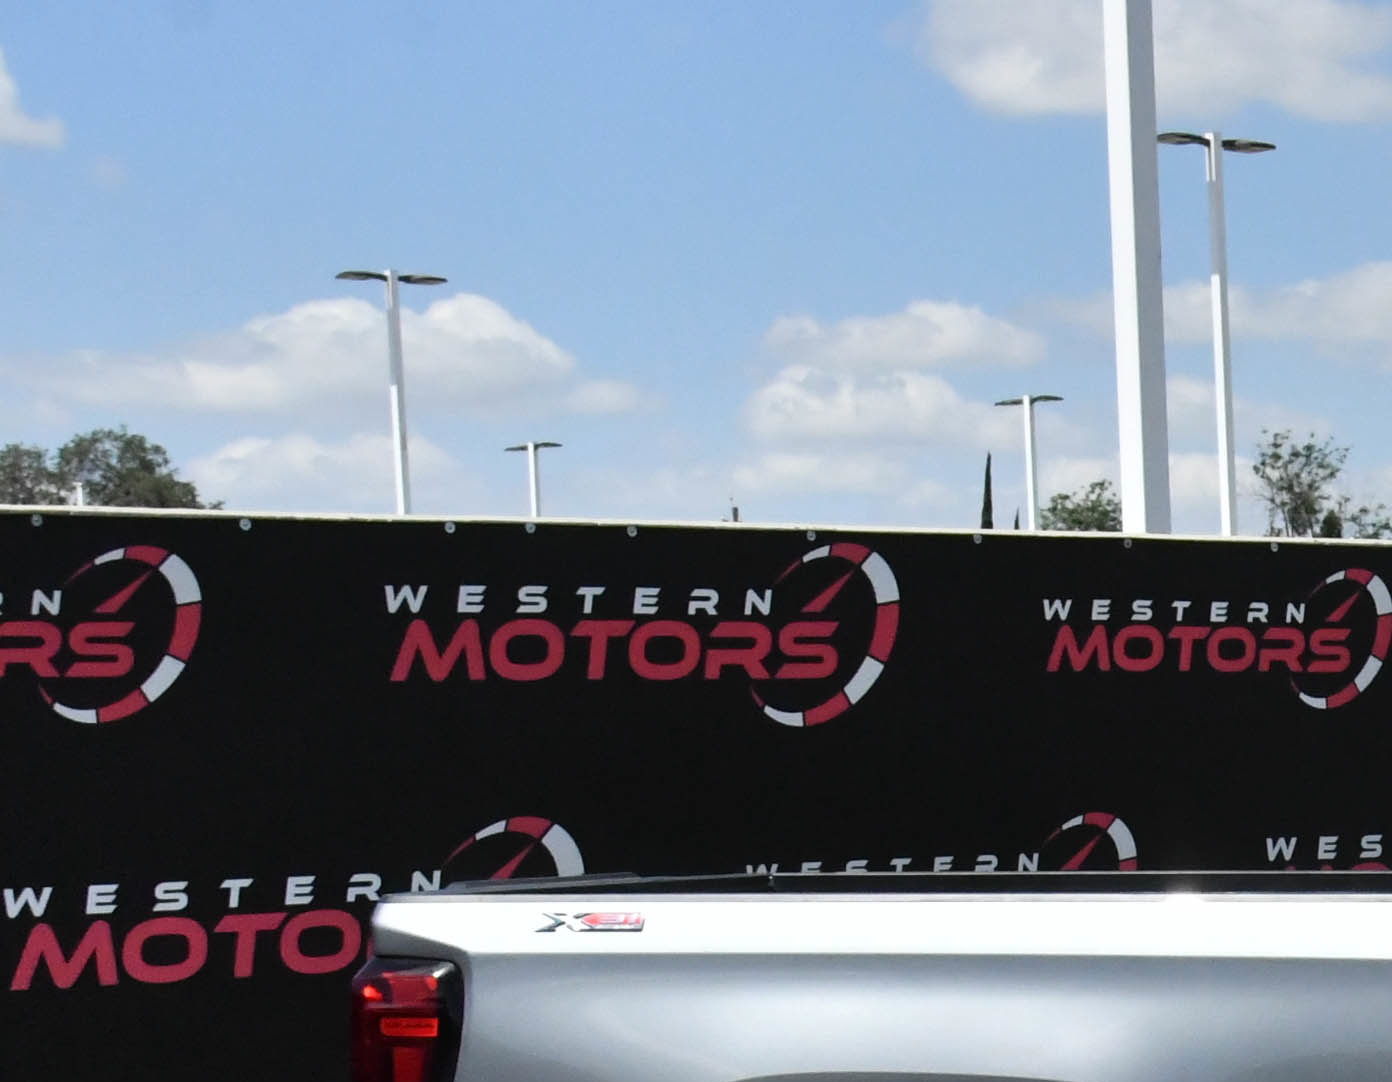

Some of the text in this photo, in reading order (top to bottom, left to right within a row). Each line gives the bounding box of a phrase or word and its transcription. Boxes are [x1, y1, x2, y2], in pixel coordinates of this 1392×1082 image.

[385, 585, 773, 616] WESTERN
[1042, 599, 1306, 624] WESTERN
[391, 618, 839, 682] MOTORS
[1046, 624, 1352, 673] MOTORS
[3, 869, 442, 919] WESTERN
[10, 908, 376, 991] MOTO
